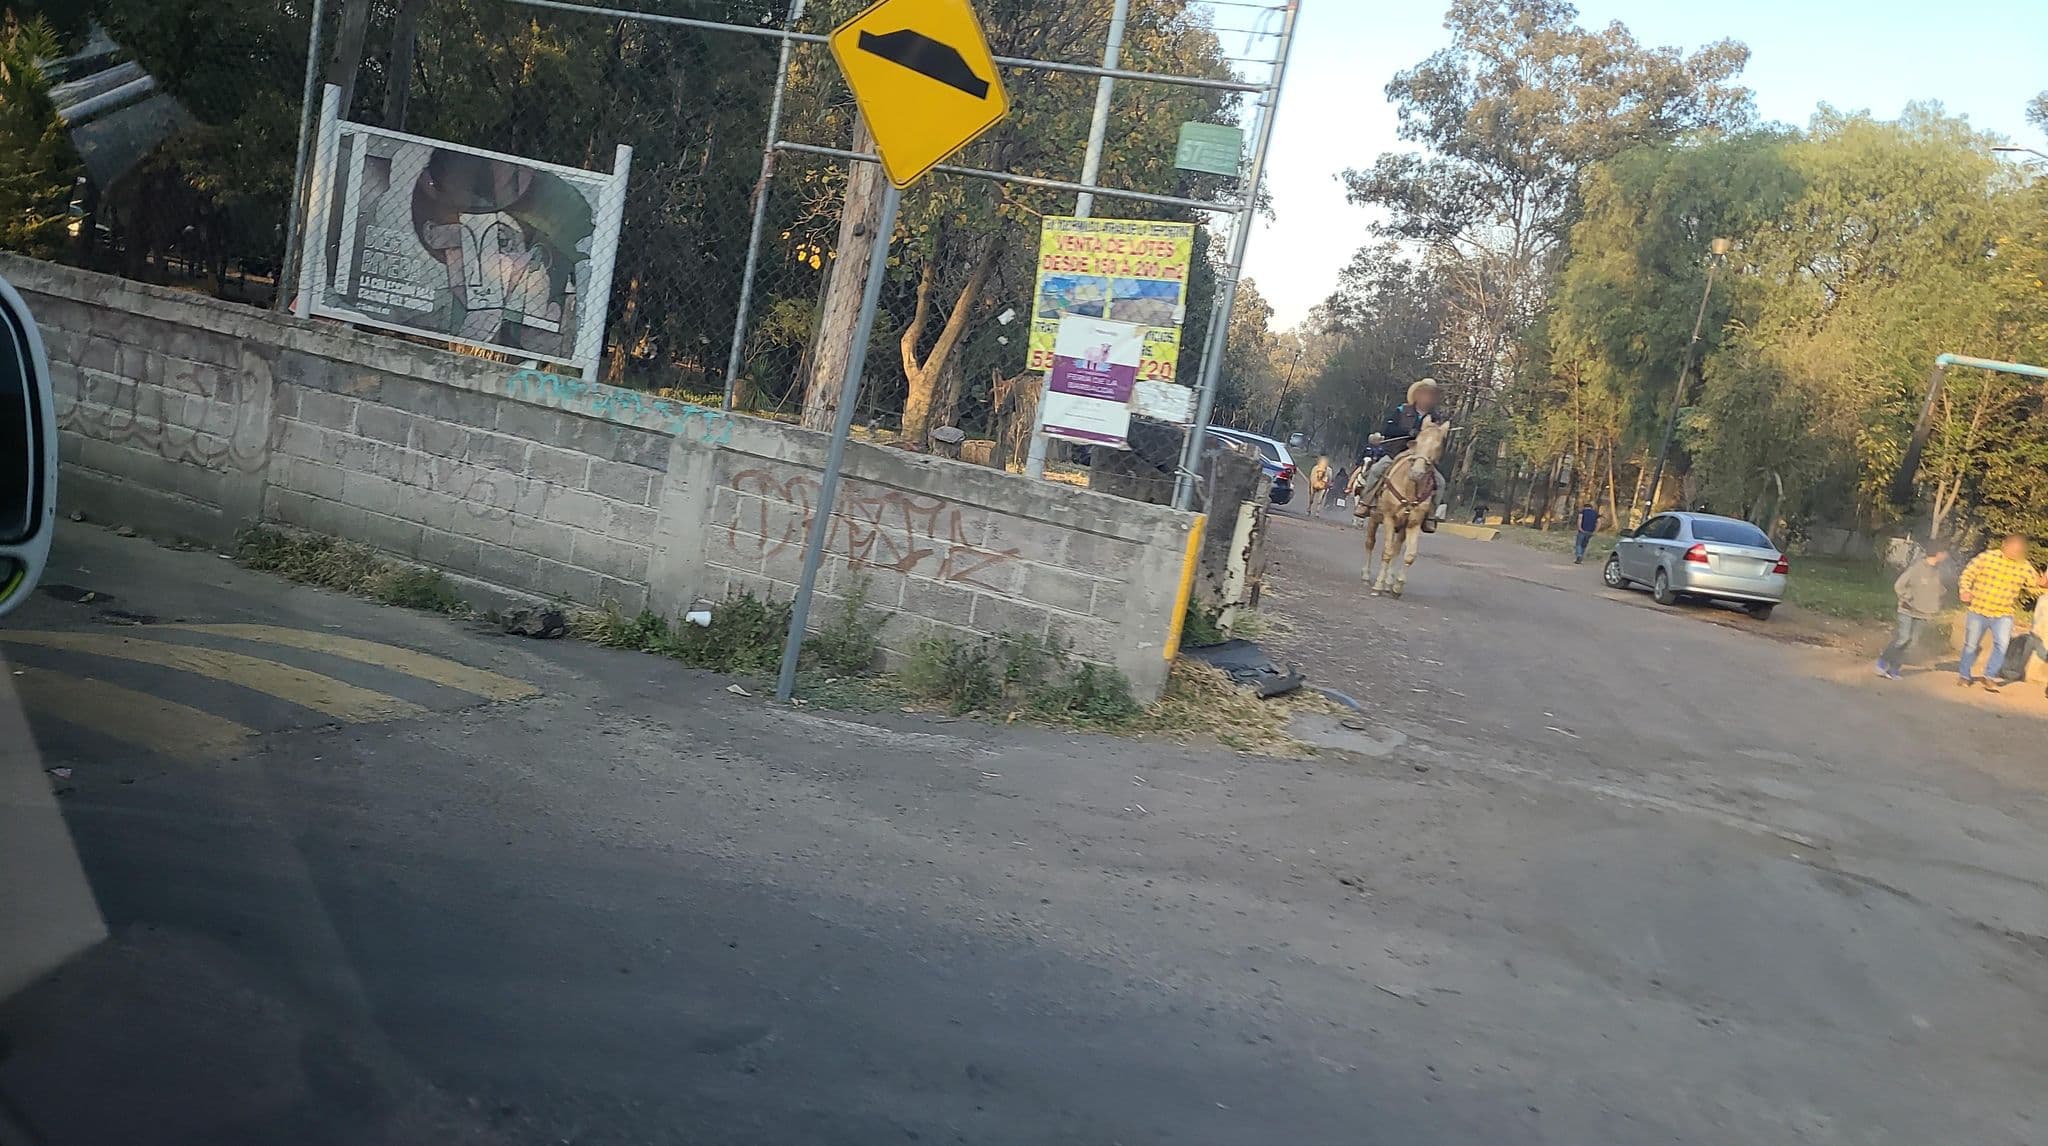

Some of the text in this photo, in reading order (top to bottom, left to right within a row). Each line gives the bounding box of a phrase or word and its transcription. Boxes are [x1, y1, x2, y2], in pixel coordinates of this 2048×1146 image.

[1057, 234, 1176, 258] VENTA DE LOTES
[1043, 254, 1089, 273] DESDE
[1066, 372, 1092, 382] FERIA
[1092, 376, 1106, 385] DE
[1106, 377, 1118, 387] LA
